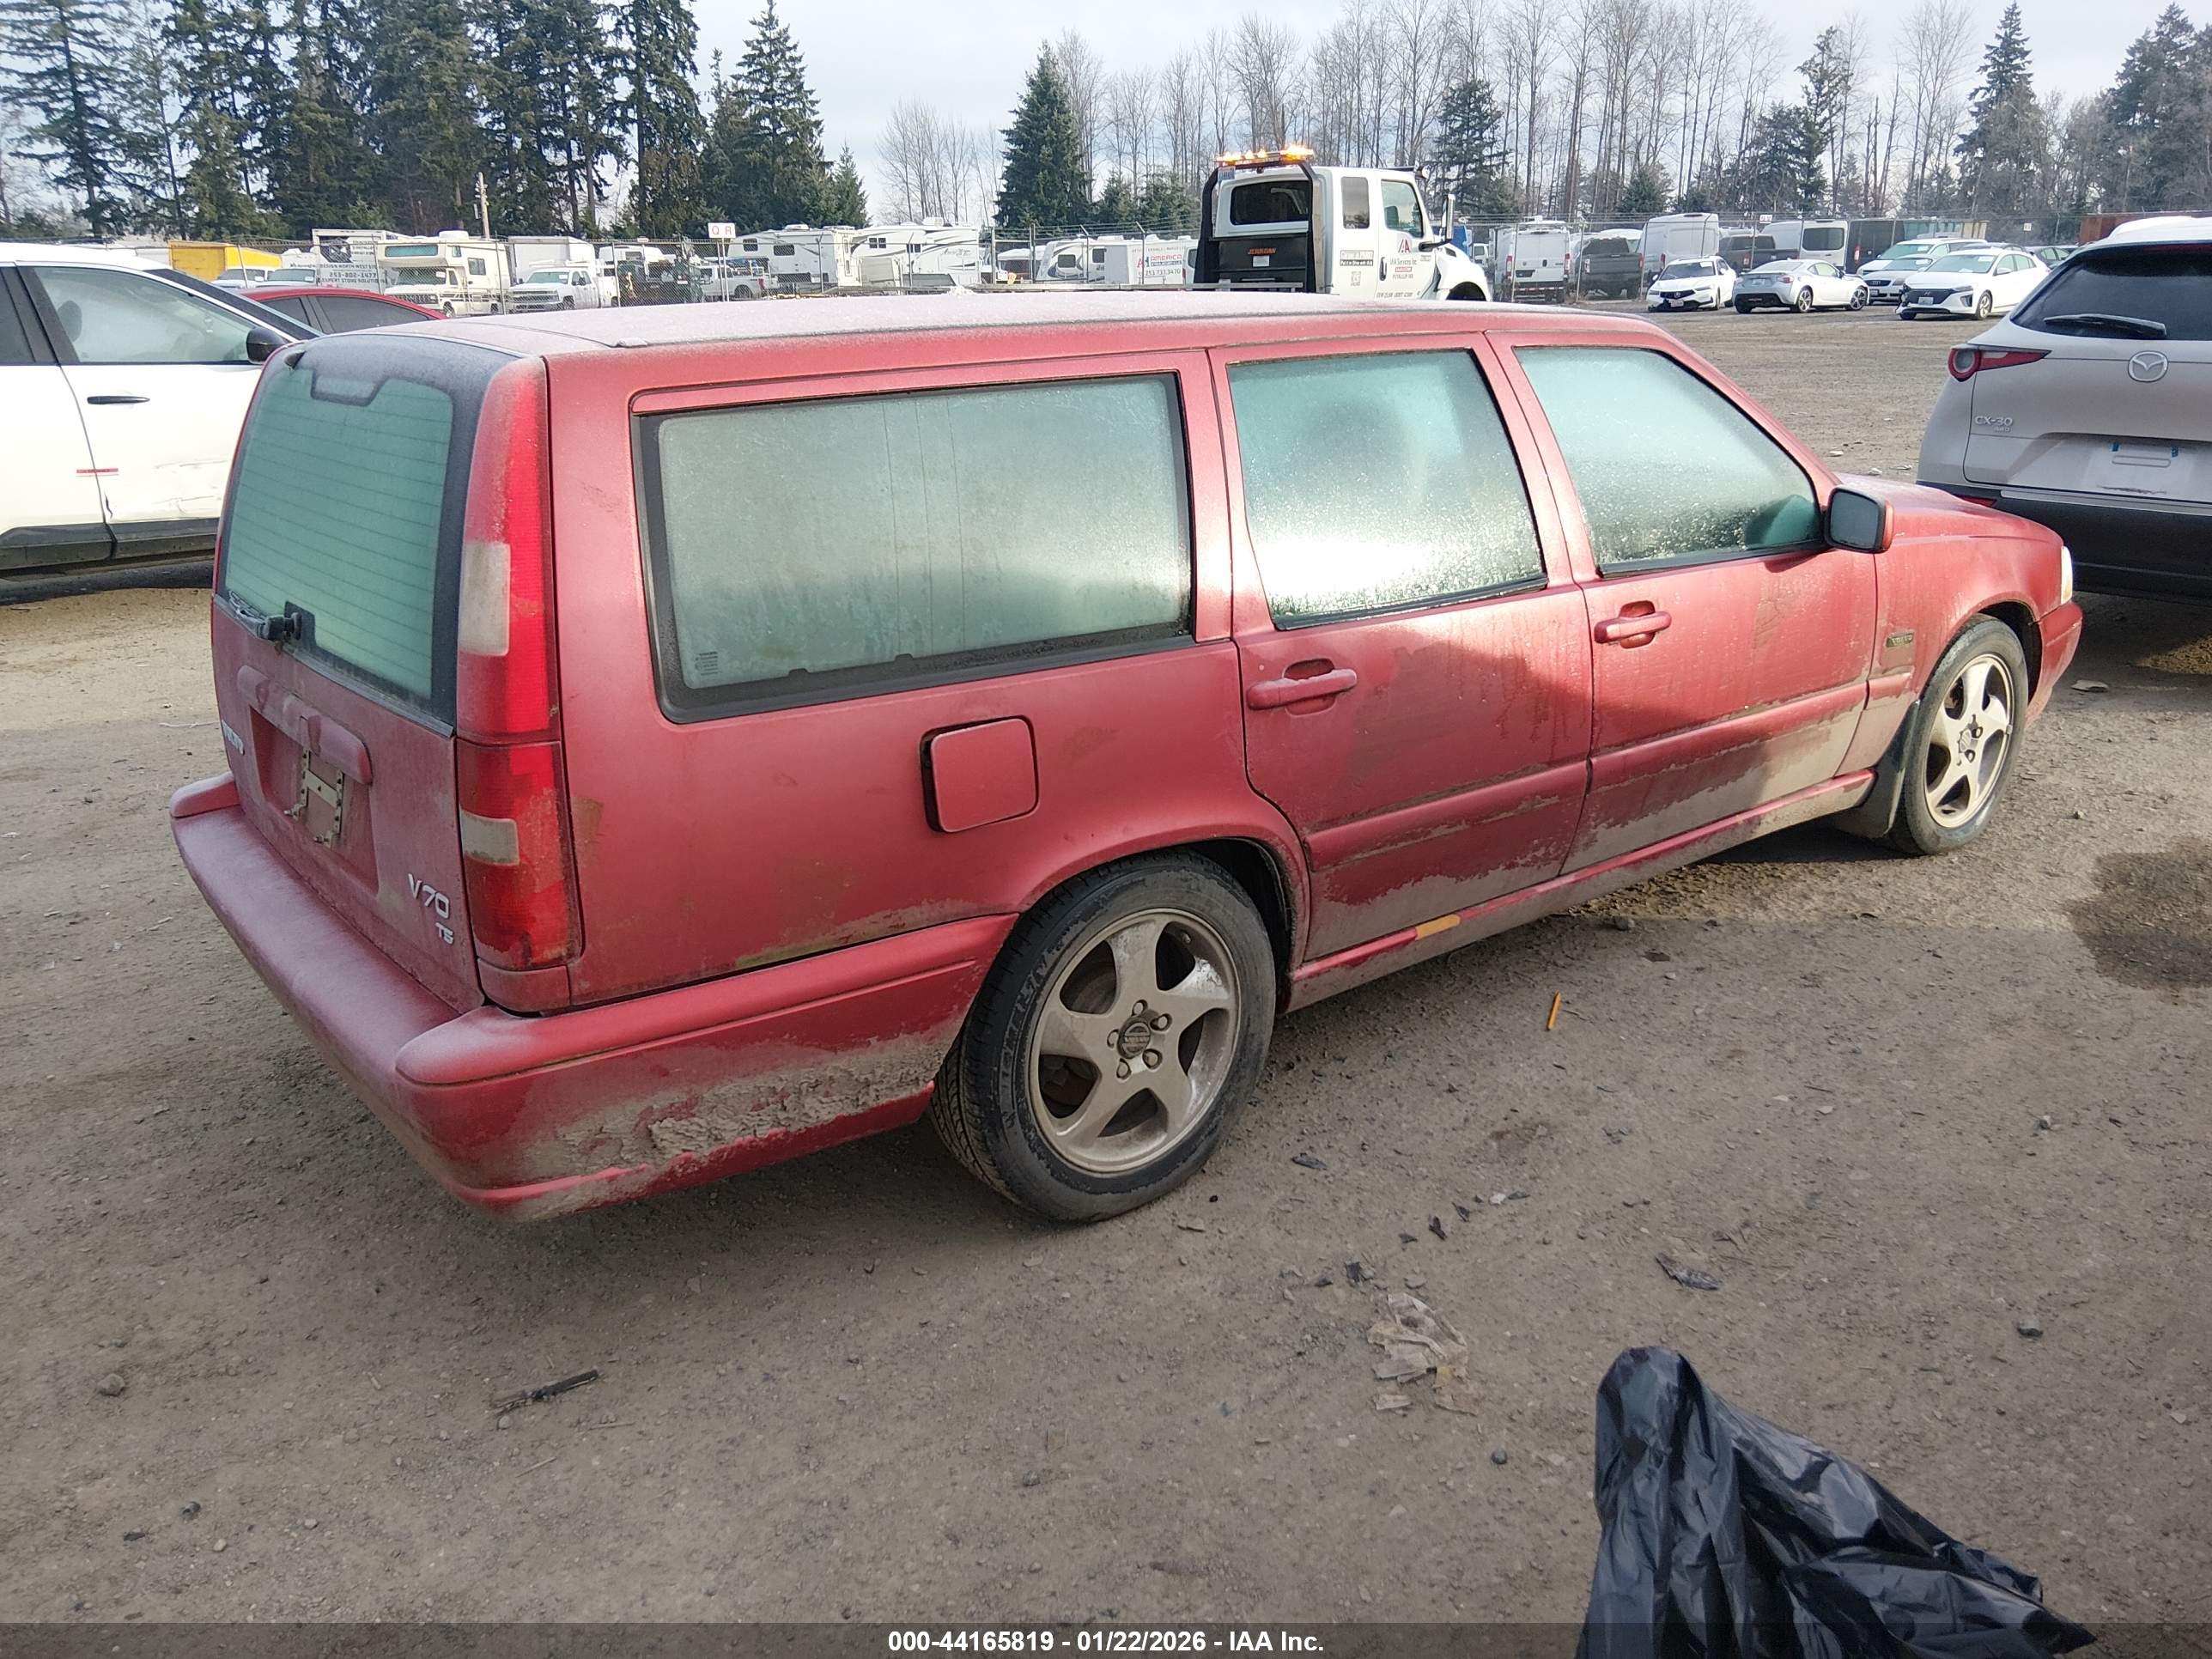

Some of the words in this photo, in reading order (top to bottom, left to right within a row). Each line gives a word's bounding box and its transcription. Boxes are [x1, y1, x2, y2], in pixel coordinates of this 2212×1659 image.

[1975, 416, 2013, 427] CX-30
[408, 872, 450, 920] V70
[435, 921, 454, 945] T5
